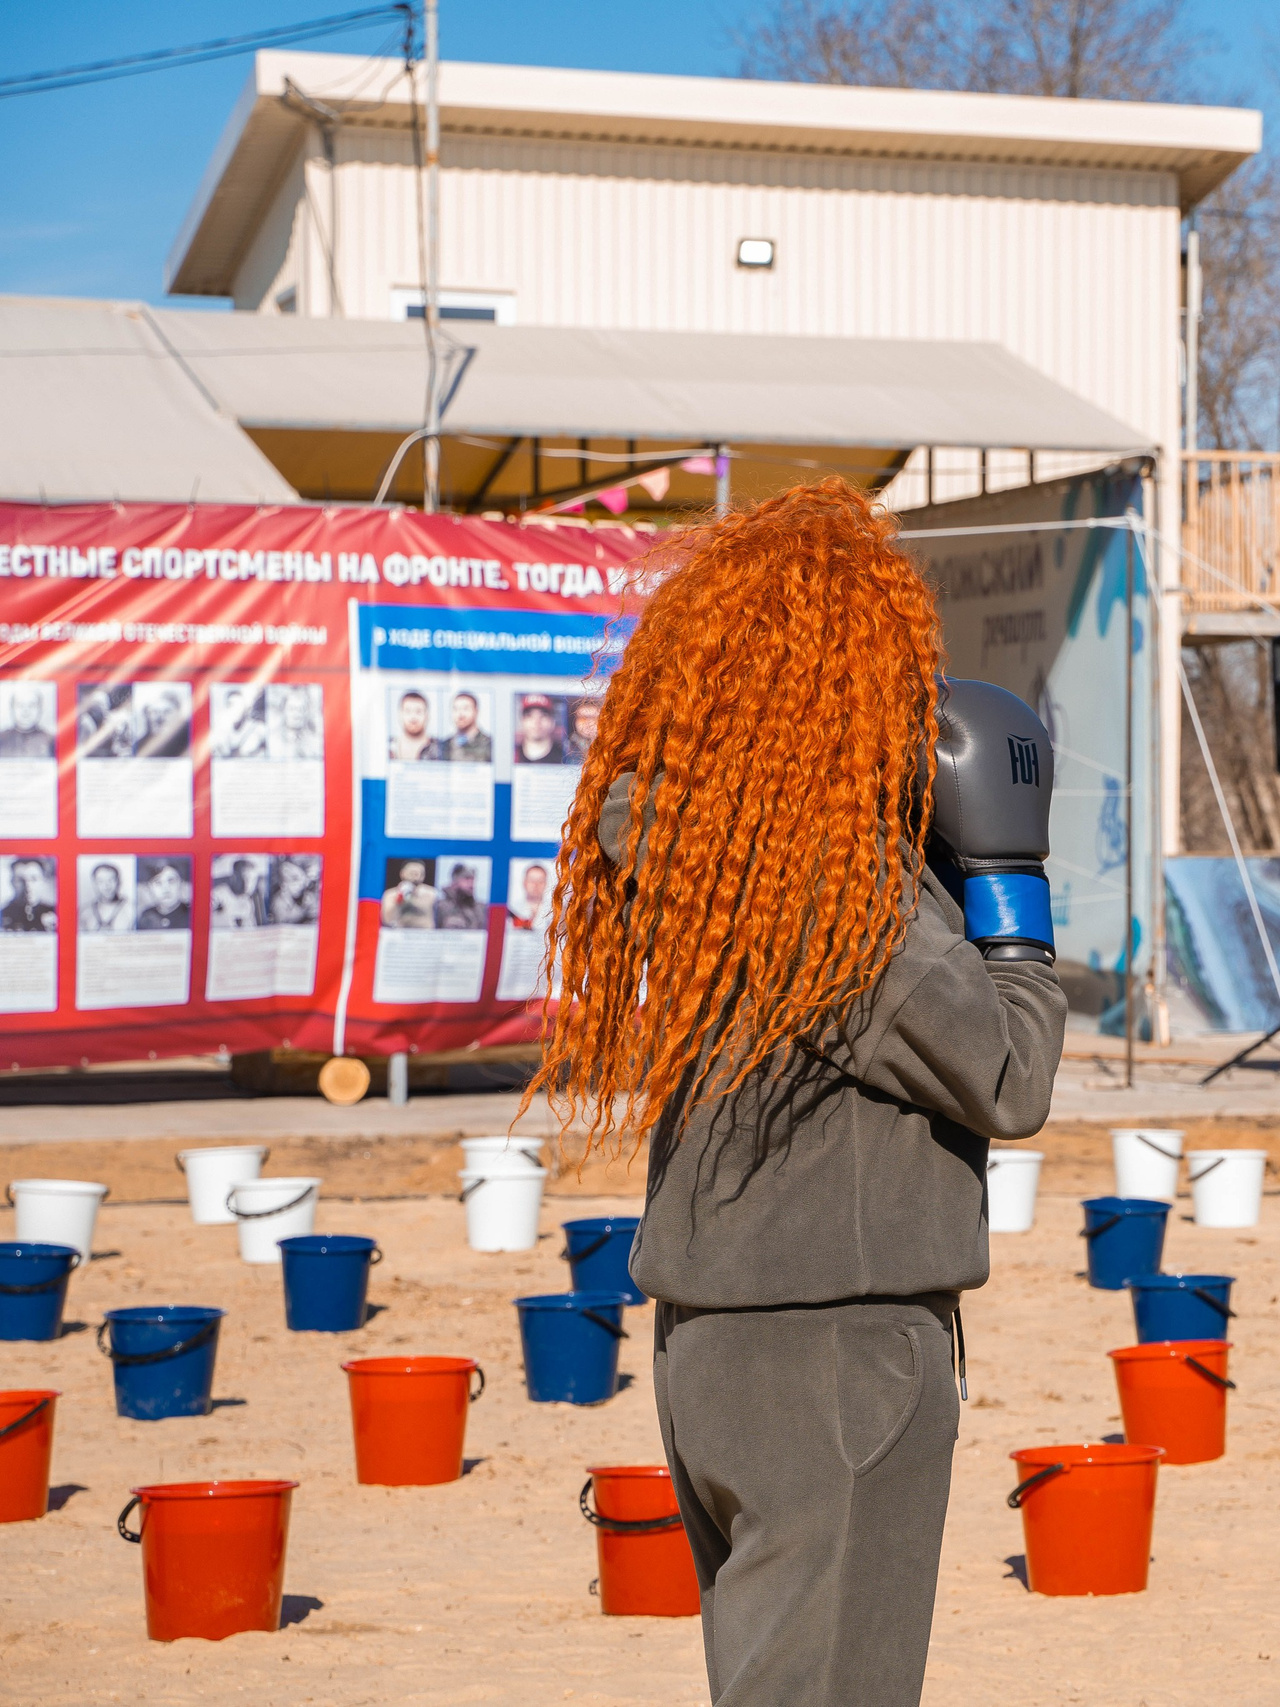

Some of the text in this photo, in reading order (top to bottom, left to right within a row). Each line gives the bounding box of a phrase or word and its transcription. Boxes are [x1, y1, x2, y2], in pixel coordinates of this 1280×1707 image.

[0, 544, 117, 578] ЕСТНЫЕ
[122, 546, 332, 582] СПОРТСМЕНЫ
[338, 551, 380, 584] НА
[382, 552, 509, 590] ФРОНТЕ.
[512, 561, 604, 598] ТОГДА
[123, 621, 263, 644] ОТЕЧЕСТВЕННОЙ
[265, 622, 327, 645] ВОЙНЫ
[373, 626, 387, 647] В
[388, 628, 432, 650] ХОДЕ
[433, 629, 552, 652] СПЕЦИАЛЬНОЙ
